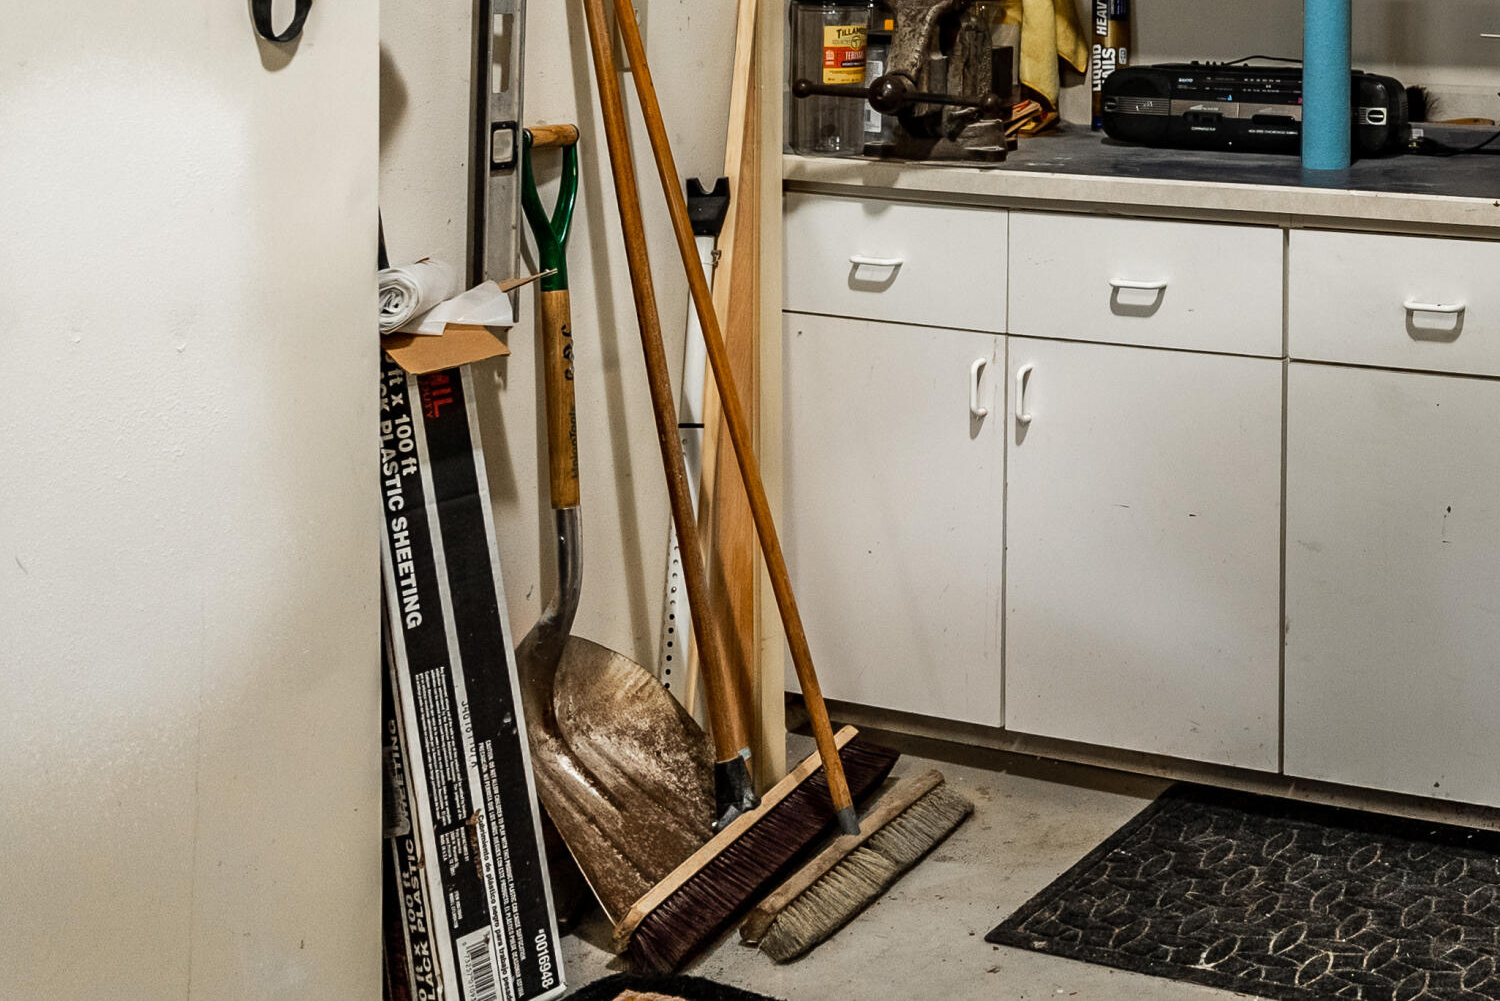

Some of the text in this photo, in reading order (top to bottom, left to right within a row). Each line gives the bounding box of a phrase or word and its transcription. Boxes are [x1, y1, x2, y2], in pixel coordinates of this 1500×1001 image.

[1092, 44, 1102, 92] LIQUID
[1102, 47, 1116, 85] AILS
[389, 392, 404, 407] x
[392, 412, 416, 454] 100
[379, 419, 404, 511] PLASTIC
[399, 456, 419, 476] ft
[389, 515, 423, 629] SHEETING
[477, 814, 490, 860] Cubrimiento
[400, 869, 411, 887] ft
[485, 862, 492, 872] de
[405, 837, 426, 933] PLASTIC
[486, 873, 497, 904] plástico
[404, 892, 418, 933] 100
[491, 906, 500, 926] negro
[412, 942, 421, 956] x
[494, 928, 503, 946] para
[414, 964, 424, 981] ft
[498, 947, 509, 975] trabajo
[534, 928, 553, 989] #0016948
